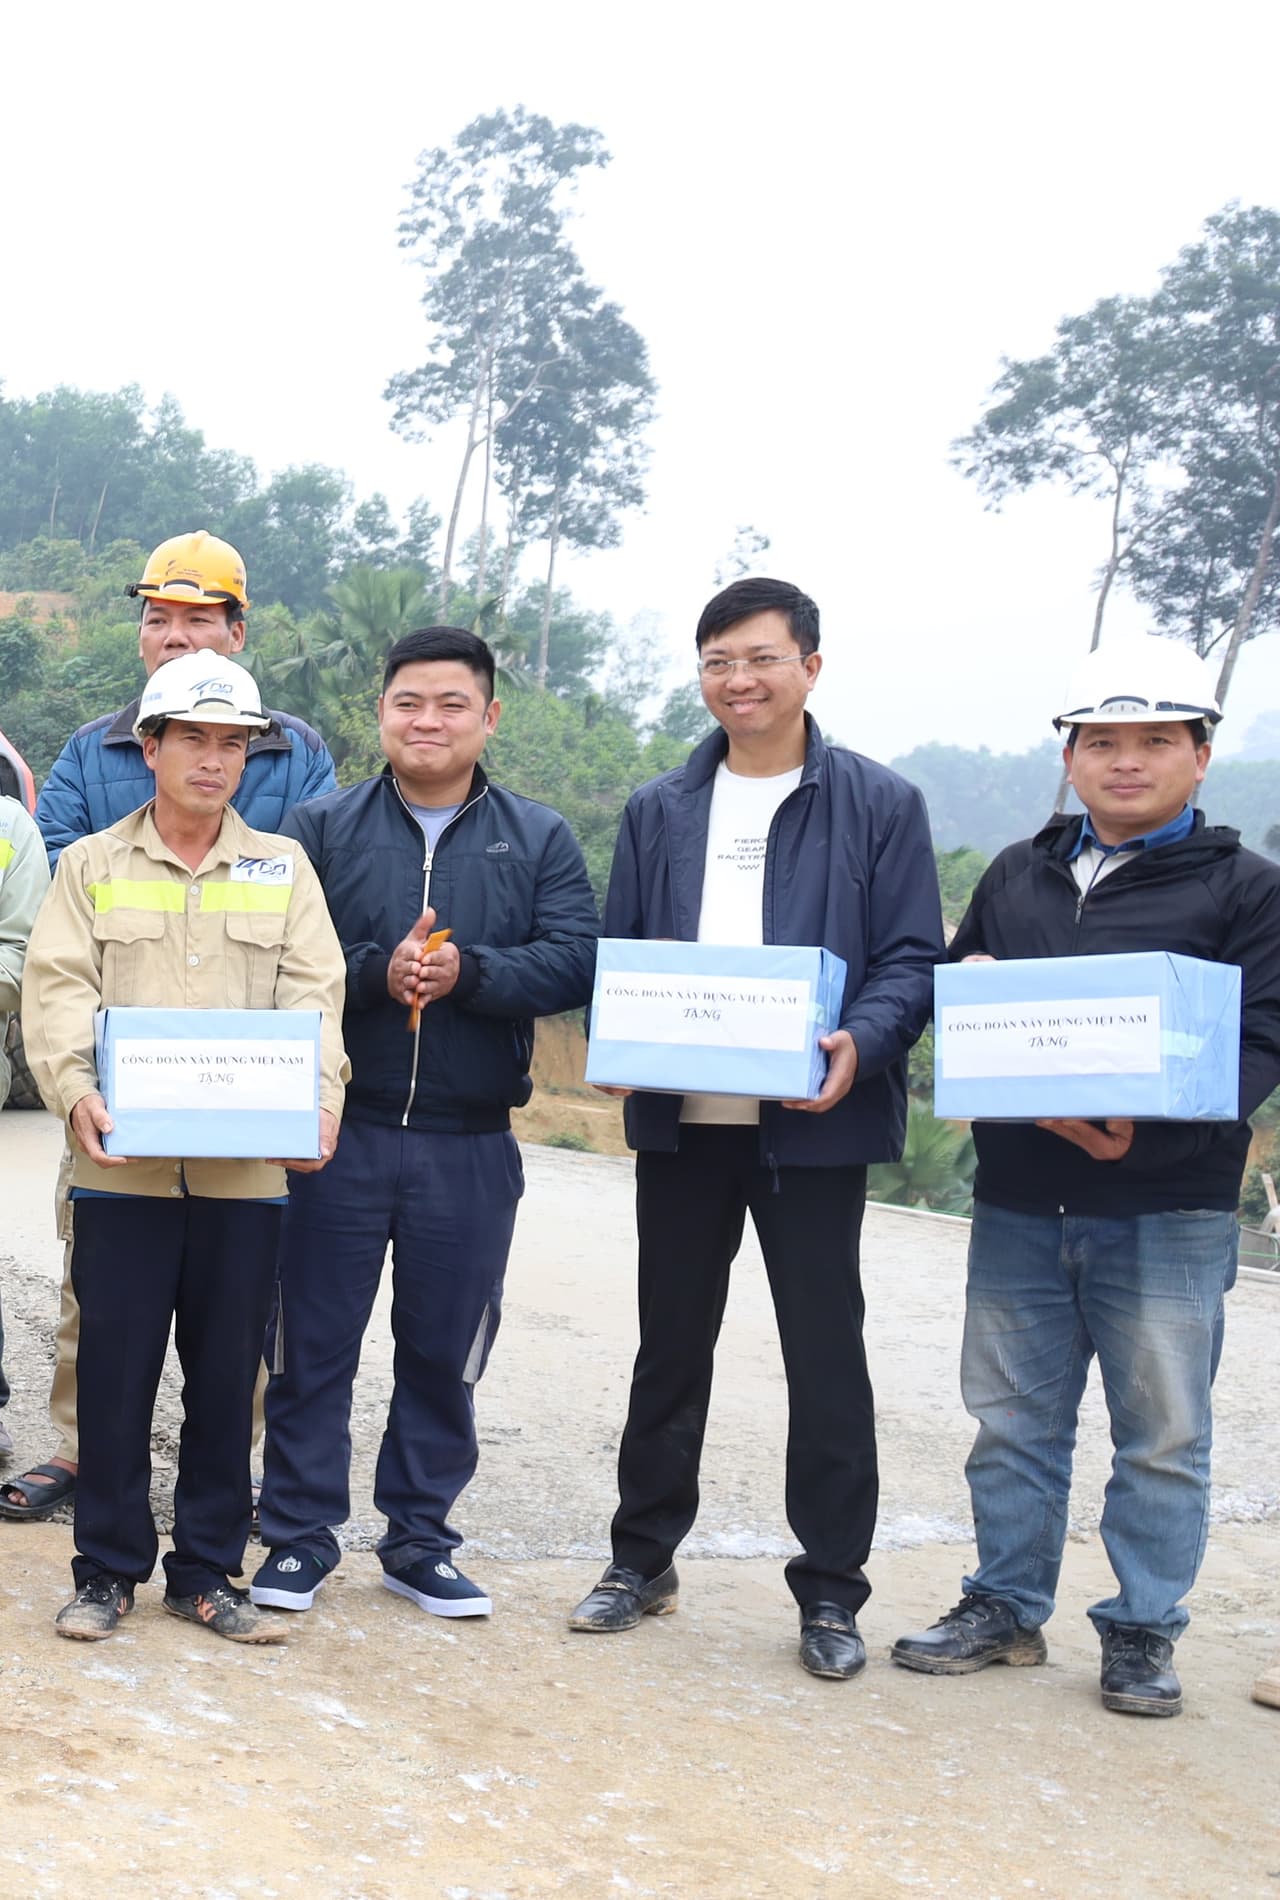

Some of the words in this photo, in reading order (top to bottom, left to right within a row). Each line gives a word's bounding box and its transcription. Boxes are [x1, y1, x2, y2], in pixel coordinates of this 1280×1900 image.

[769, 996, 798, 1006] NAM
[1119, 1014, 1148, 1024] NAM
[278, 1056, 305, 1065] NAM
